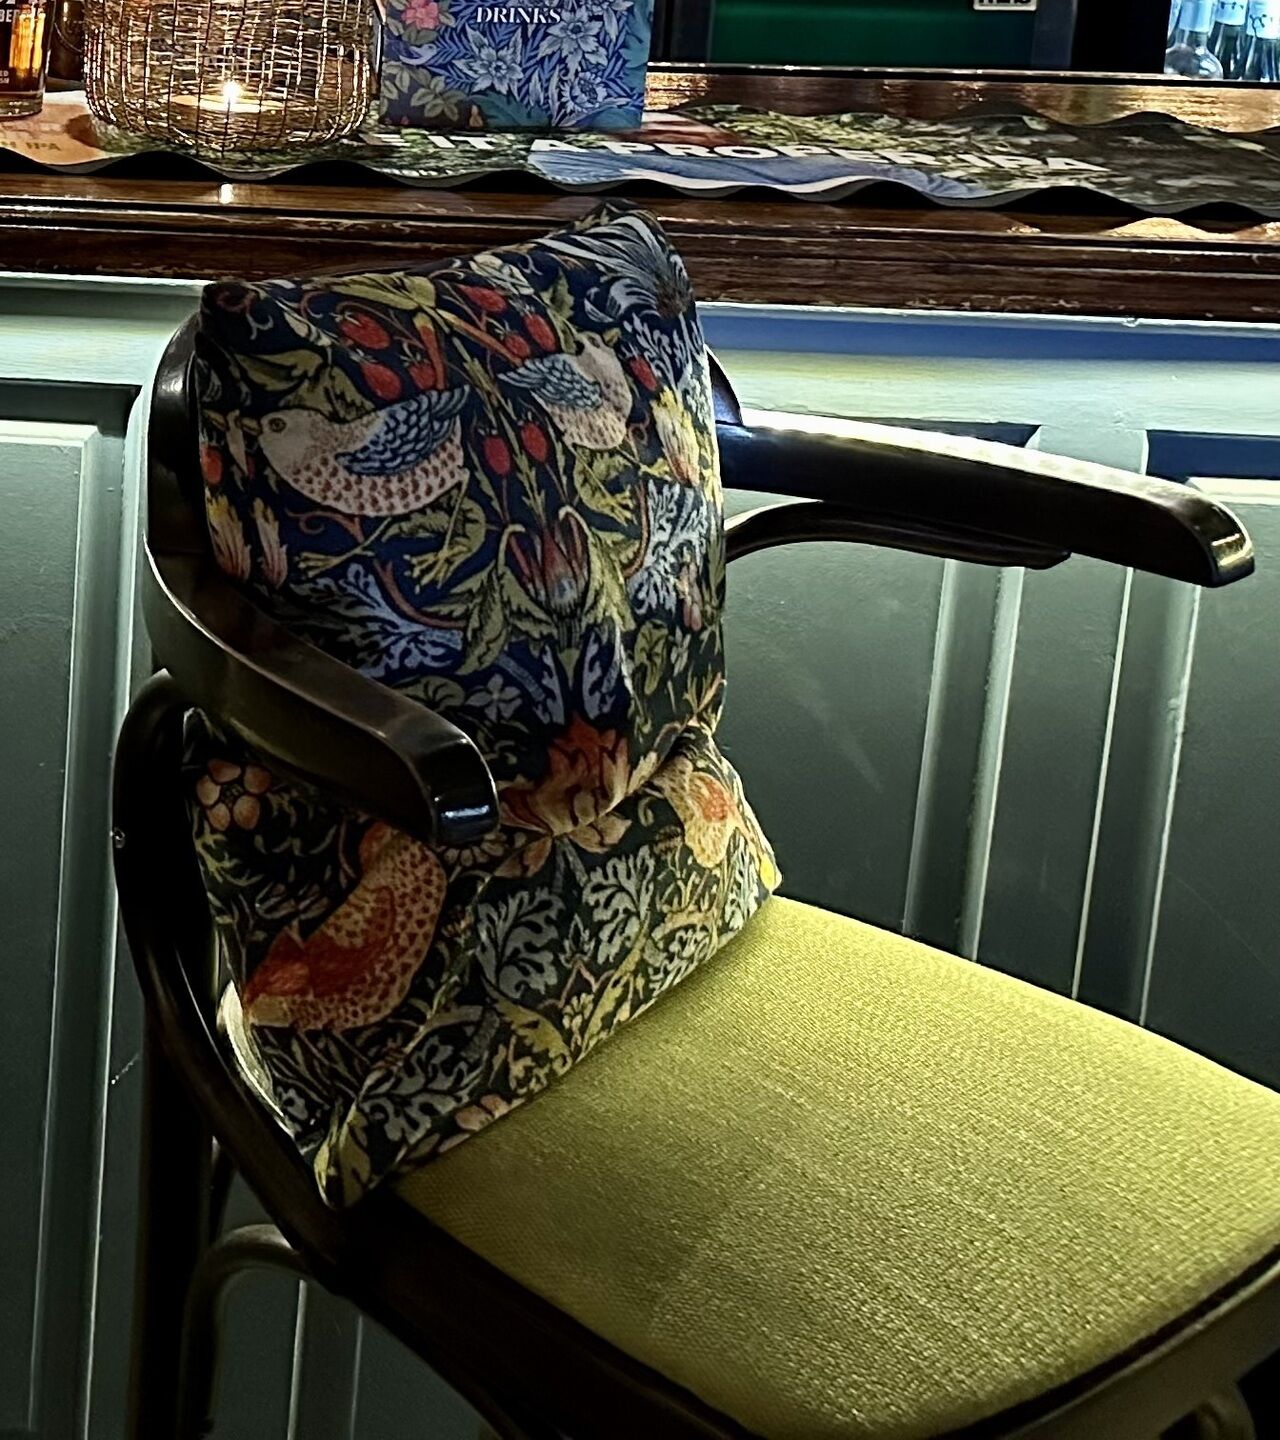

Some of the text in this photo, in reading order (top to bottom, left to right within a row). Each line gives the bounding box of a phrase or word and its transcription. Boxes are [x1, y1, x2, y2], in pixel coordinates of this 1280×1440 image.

[475, 6, 562, 25] DRINKS
[529, 139, 591, 153] A
[601, 140, 947, 166] PROPER
[951, 152, 1112, 172] IPA
